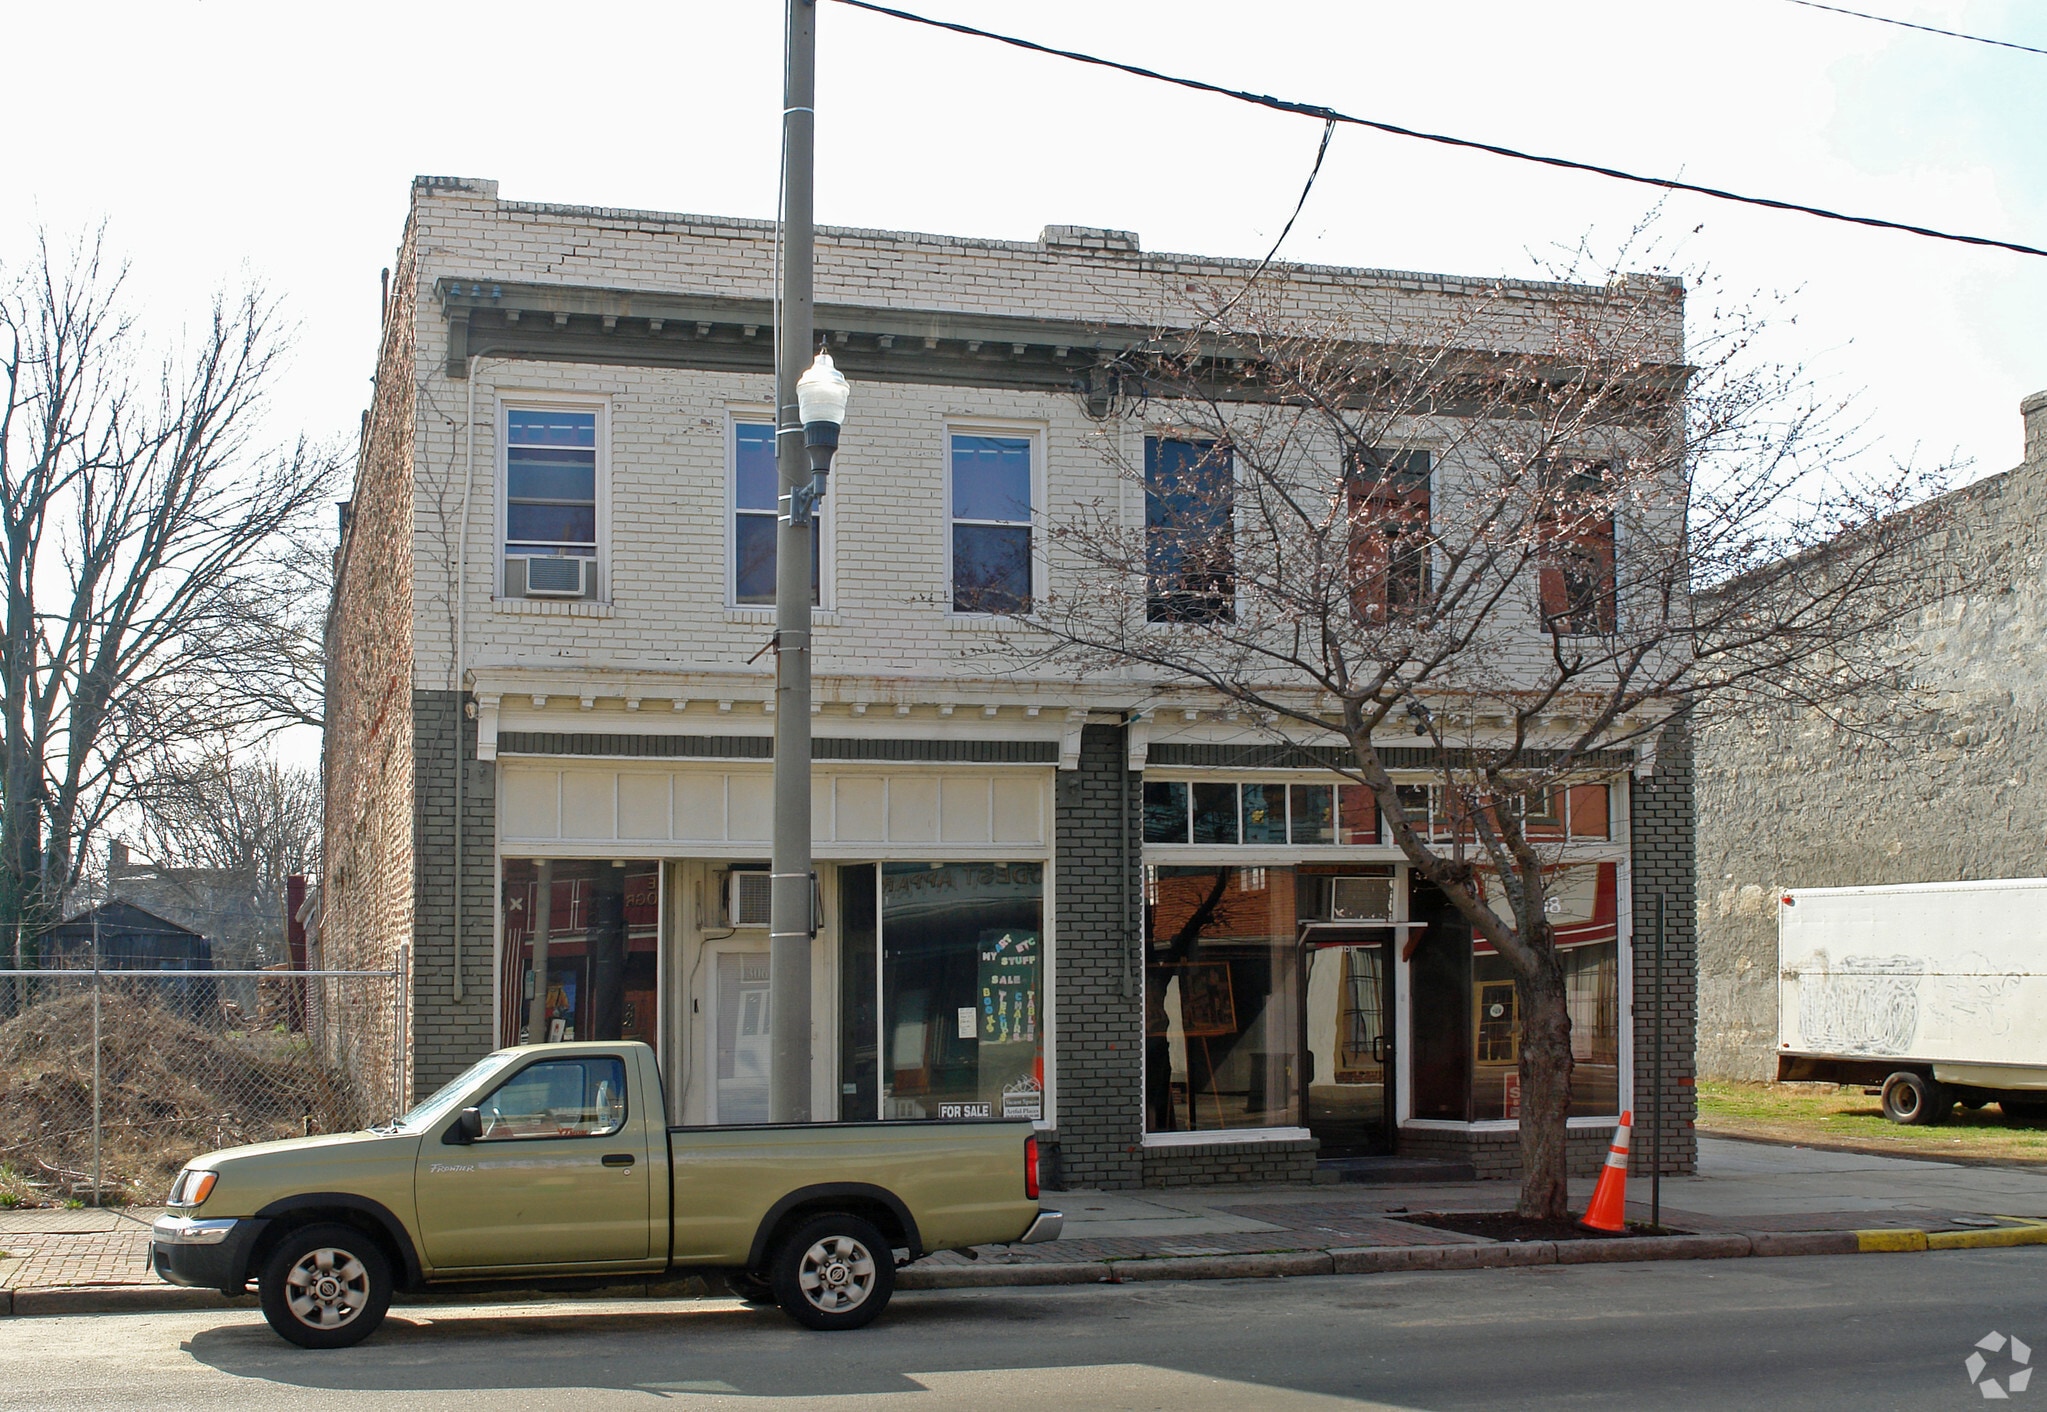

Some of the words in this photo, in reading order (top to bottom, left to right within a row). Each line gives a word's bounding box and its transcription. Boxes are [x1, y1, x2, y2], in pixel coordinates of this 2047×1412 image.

[995, 933, 1012, 953] ART
[1015, 937, 1036, 953] ETC
[982, 951, 997, 961] MY
[1001, 955, 1036, 965] STUFF
[991, 975, 1021, 985] SALE
[983, 987, 996, 1033] BOOKS
[1013, 992, 1022, 1042] CHAIRS
[1027, 990, 1035, 1042] TABLES
[941, 1105, 961, 1117] FOR
[963, 1105, 989, 1117] SALE
